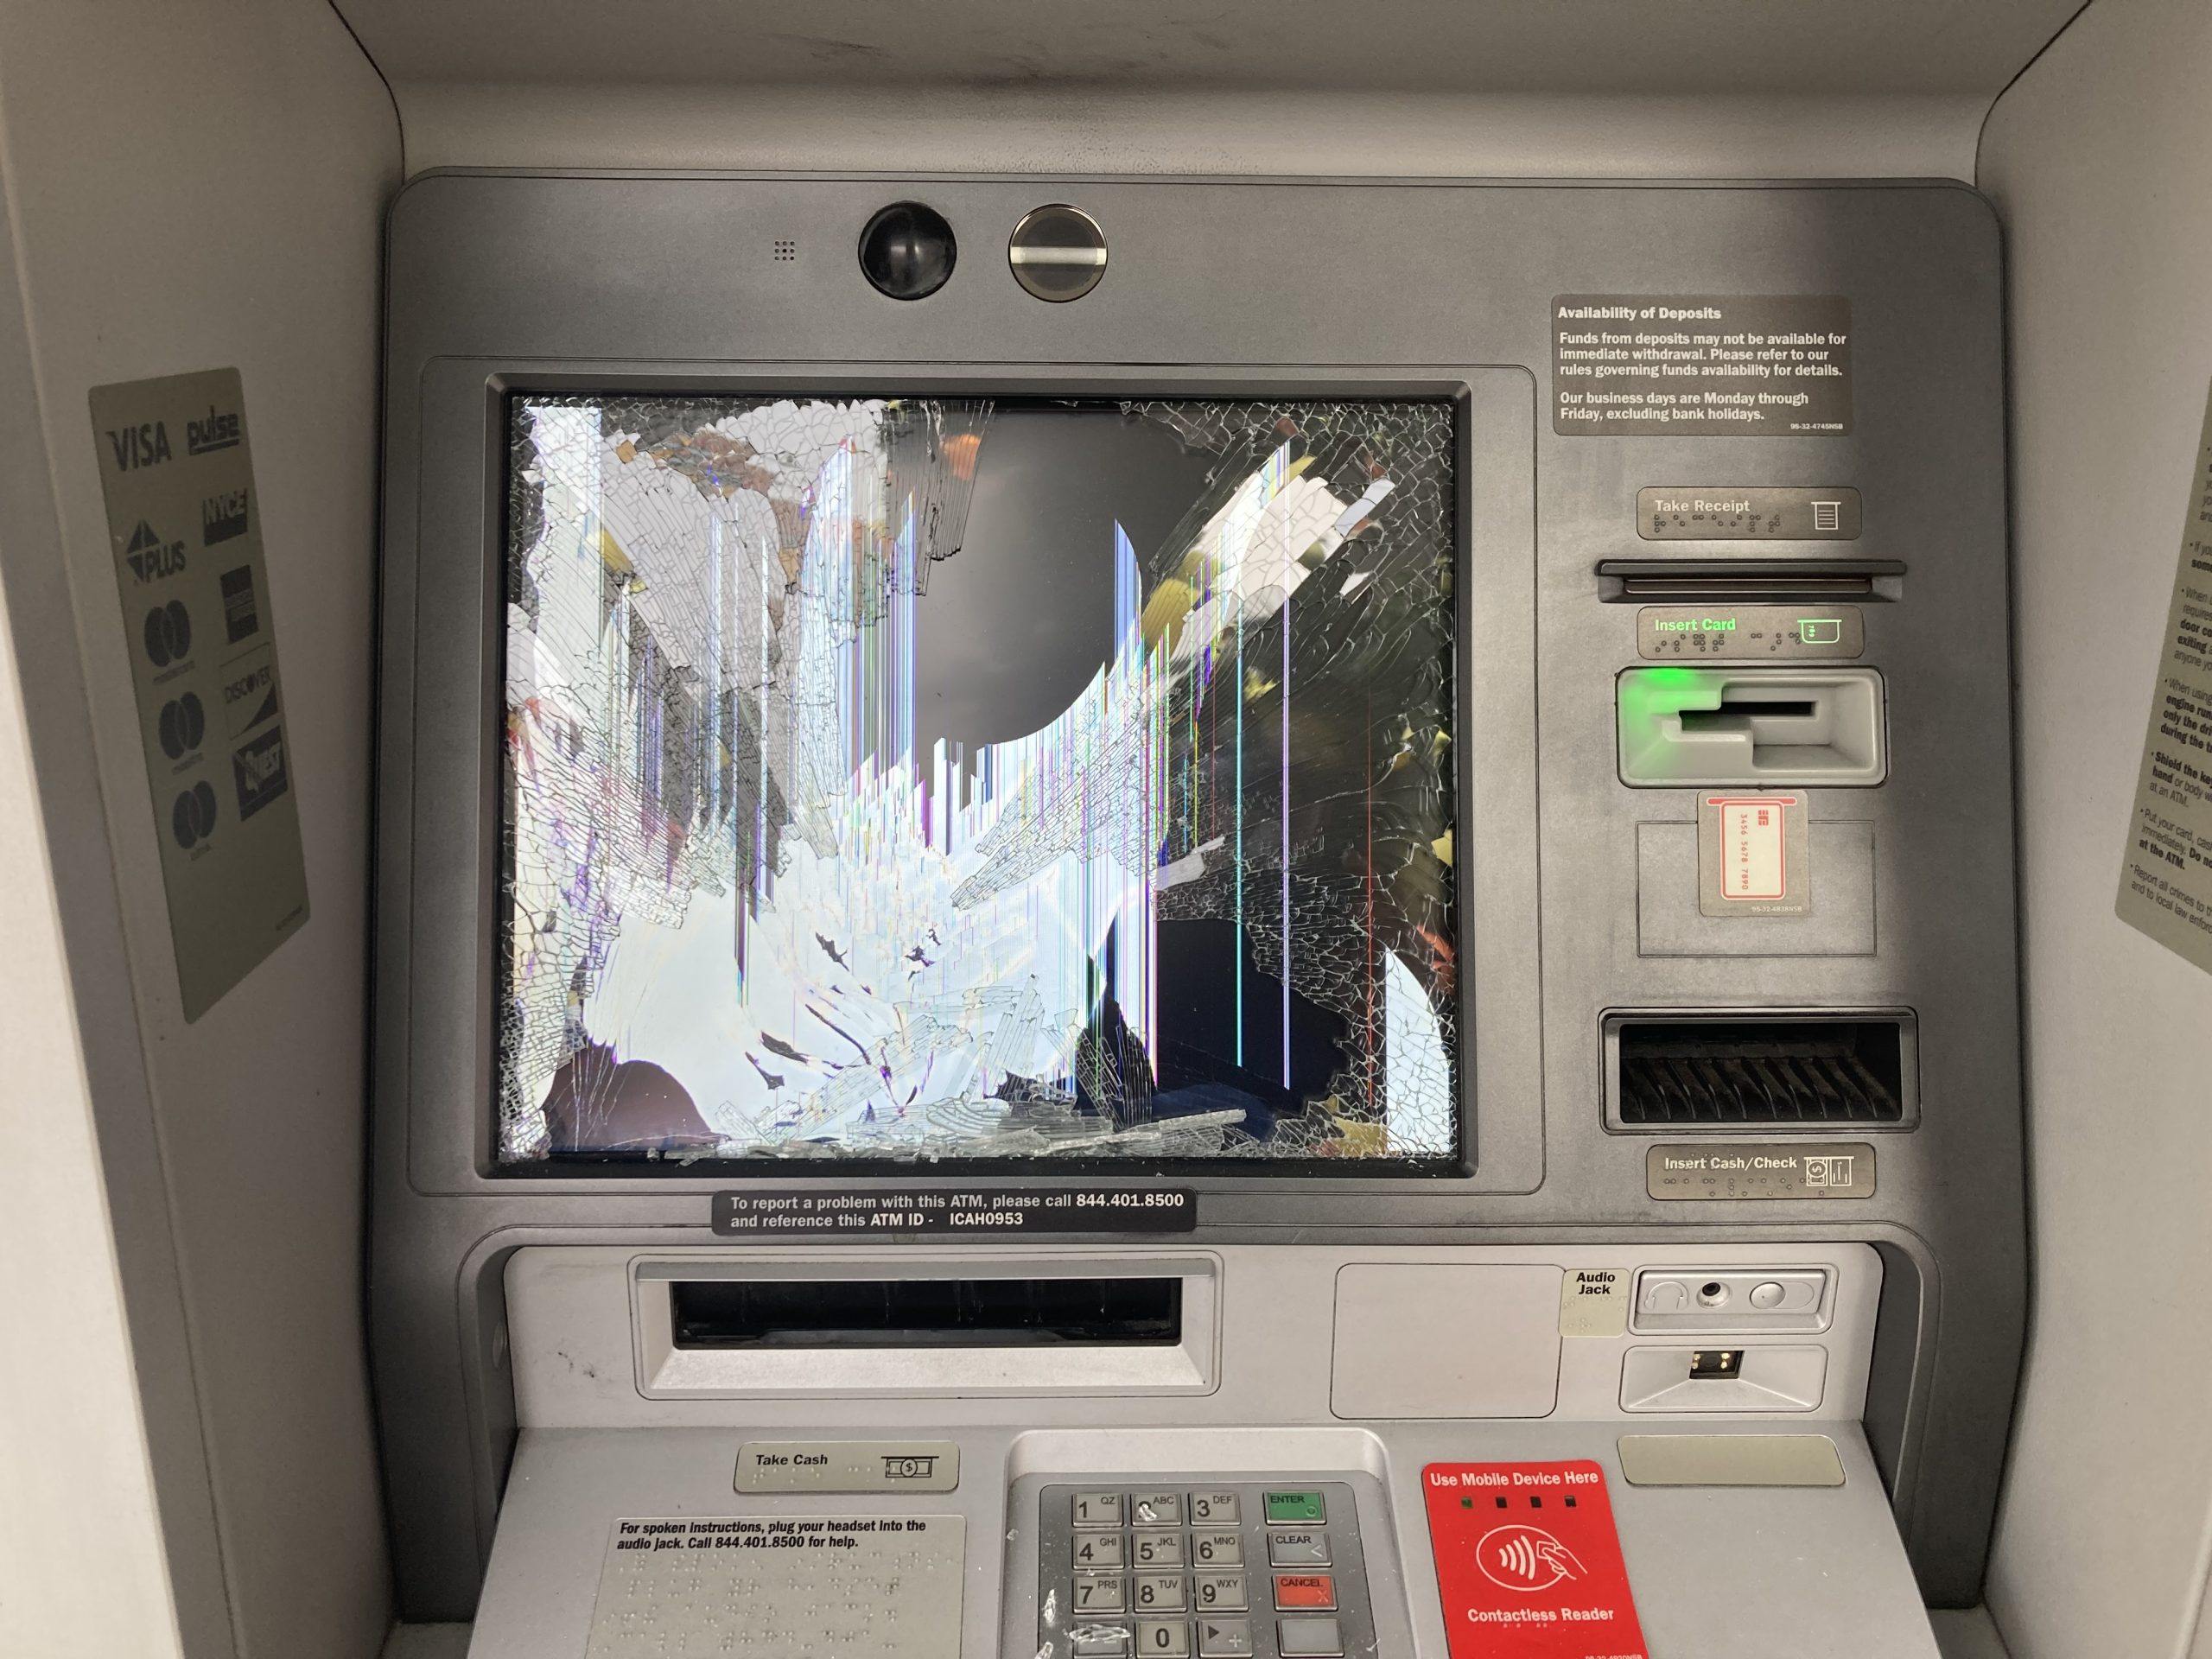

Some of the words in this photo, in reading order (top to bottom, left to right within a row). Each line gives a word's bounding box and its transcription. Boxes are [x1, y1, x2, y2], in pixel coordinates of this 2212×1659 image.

[1558, 307, 1637, 321] Availability
[1640, 307, 1656, 319] of
[1659, 307, 1722, 321] Deposits
[1560, 332, 1599, 344] Funds
[1601, 332, 1632, 344] from
[1635, 332, 1690, 346] deposits
[1694, 335, 1720, 346] may
[1723, 334, 1745, 345] not
[1747, 333, 1764, 345] be
[1767, 333, 1825, 345] available
[1827, 333, 1847, 345] for
[1560, 347, 1629, 359] immediate
[1632, 347, 1707, 359] withdrawal.
[1710, 348, 1753, 360] Please
[1757, 348, 1788, 360] refer
[1790, 349, 1804, 360] to
[1807, 351, 1829, 360] our
[1560, 364, 1592, 375] rules
[1595, 365, 1660, 378] governing
[1662, 364, 1698, 376] funds
[1701, 364, 1770, 378] availability
[1773, 364, 1792, 376] for
[1795, 364, 1842, 376] details.
[1560, 392, 1583, 404] Our
[1586, 391, 1643, 404] business
[1646, 392, 1676, 406] days
[1679, 395, 1701, 404] are
[1704, 392, 1756, 407] Monday
[1758, 392, 1809, 406] through
[1560, 408, 1604, 422] Friday,
[1606, 408, 1669, 422] excluding
[1672, 408, 1705, 420] bank
[1708, 408, 1764, 422] holidays.
[105, 421, 172, 472] VISA
[205, 490, 247, 525] NYCE
[1655, 499, 1689, 512] Take
[1694, 499, 1750, 513] Receipt
[144, 540, 187, 583] PLUS
[1655, 619, 1698, 631] Insert
[1701, 618, 1736, 631] Card
[2180, 619, 2201, 633] door
[2177, 636, 2208, 655] exiting
[2166, 695, 2195, 713] engine
[2163, 710, 2181, 725] only
[2183, 715, 2197, 731] the
[2161, 722, 2188, 745] during
[2190, 734, 2203, 750] the
[2155, 751, 2182, 772] Shield
[2183, 764, 2197, 779] the
[2152, 765, 2174, 784] hand
[2139, 839, 2148, 850] at
[2150, 842, 2164, 858] the
[2165, 851, 2185, 870] ATM.
[2190, 847, 2201, 861] Do
[2132, 880, 2145, 894] and
[1664, 1157, 1707, 1169] Insert
[1710, 1156, 1797, 1171] Cash/Check
[731, 1197, 747, 1209] To
[753, 1197, 798, 1211] report
[804, 1199, 812, 1209] a
[817, 1196, 876, 1211] problem
[881, 1195, 912, 1208] with
[918, 1195, 946, 1208] this
[950, 1194, 987, 1209] ATM,
[993, 1194, 1040, 1210] please
[1045, 1194, 1071, 1207] call
[1076, 1193, 1184, 1207] 844.401.8500
[730, 1215, 757, 1227] and
[762, 1214, 833, 1227] reference
[837, 1214, 866, 1226] this
[870, 1213, 903, 1226] ATM
[908, 1212, 925, 1225] ID
[950, 1212, 1024, 1225] ICAH0953
[1576, 1271, 1616, 1283] Audio
[1578, 1283, 1611, 1295] Jack
[755, 1454, 789, 1465] Take
[793, 1454, 828, 1465] Cash
[1430, 1472, 1458, 1486] Use
[1461, 1472, 1509, 1485] Mobile
[1513, 1471, 1560, 1485] Device
[1564, 1471, 1599, 1484] Here
[1197, 1499, 1211, 1517] 3
[1212, 1496, 1232, 1504] DEF
[1270, 1495, 1305, 1503] ENTER
[1078, 1501, 1088, 1518] 1
[1100, 1497, 1116, 1505] QZ
[620, 1522, 640, 1534] For
[642, 1522, 686, 1535] spoken
[690, 1522, 765, 1534] instructions,
[768, 1521, 796, 1535] plug
[798, 1522, 824, 1534] your
[827, 1521, 876, 1531] headset
[879, 1521, 903, 1531] into
[906, 1520, 926, 1531] the
[617, 1537, 652, 1549] audio
[653, 1537, 684, 1551] jack.
[688, 1537, 712, 1548] Call
[715, 1536, 804, 1548] 844.401.8500
[808, 1535, 826, 1548] for
[829, 1535, 858, 1549] help.
[1275, 1535, 1312, 1544] CLEAR
[1079, 1542, 1094, 1560] 4
[1099, 1537, 1117, 1547] GHI
[1140, 1542, 1154, 1560] 5
[1157, 1537, 1177, 1547] JKL
[1199, 1541, 1213, 1560] 6
[1213, 1536, 1236, 1546] MNO
[1281, 1578, 1324, 1587] CANCEL
[1080, 1586, 1094, 1605] 7
[1097, 1580, 1118, 1589] PRS
[1141, 1585, 1154, 1604] 8
[1159, 1580, 1179, 1589] TUV
[1202, 1584, 1216, 1603] 9
[1216, 1579, 1238, 1588] WXY
[1467, 1608, 1557, 1622] Contactless
[1560, 1607, 1614, 1621] Reader
[1155, 1628, 1170, 1648] 0
